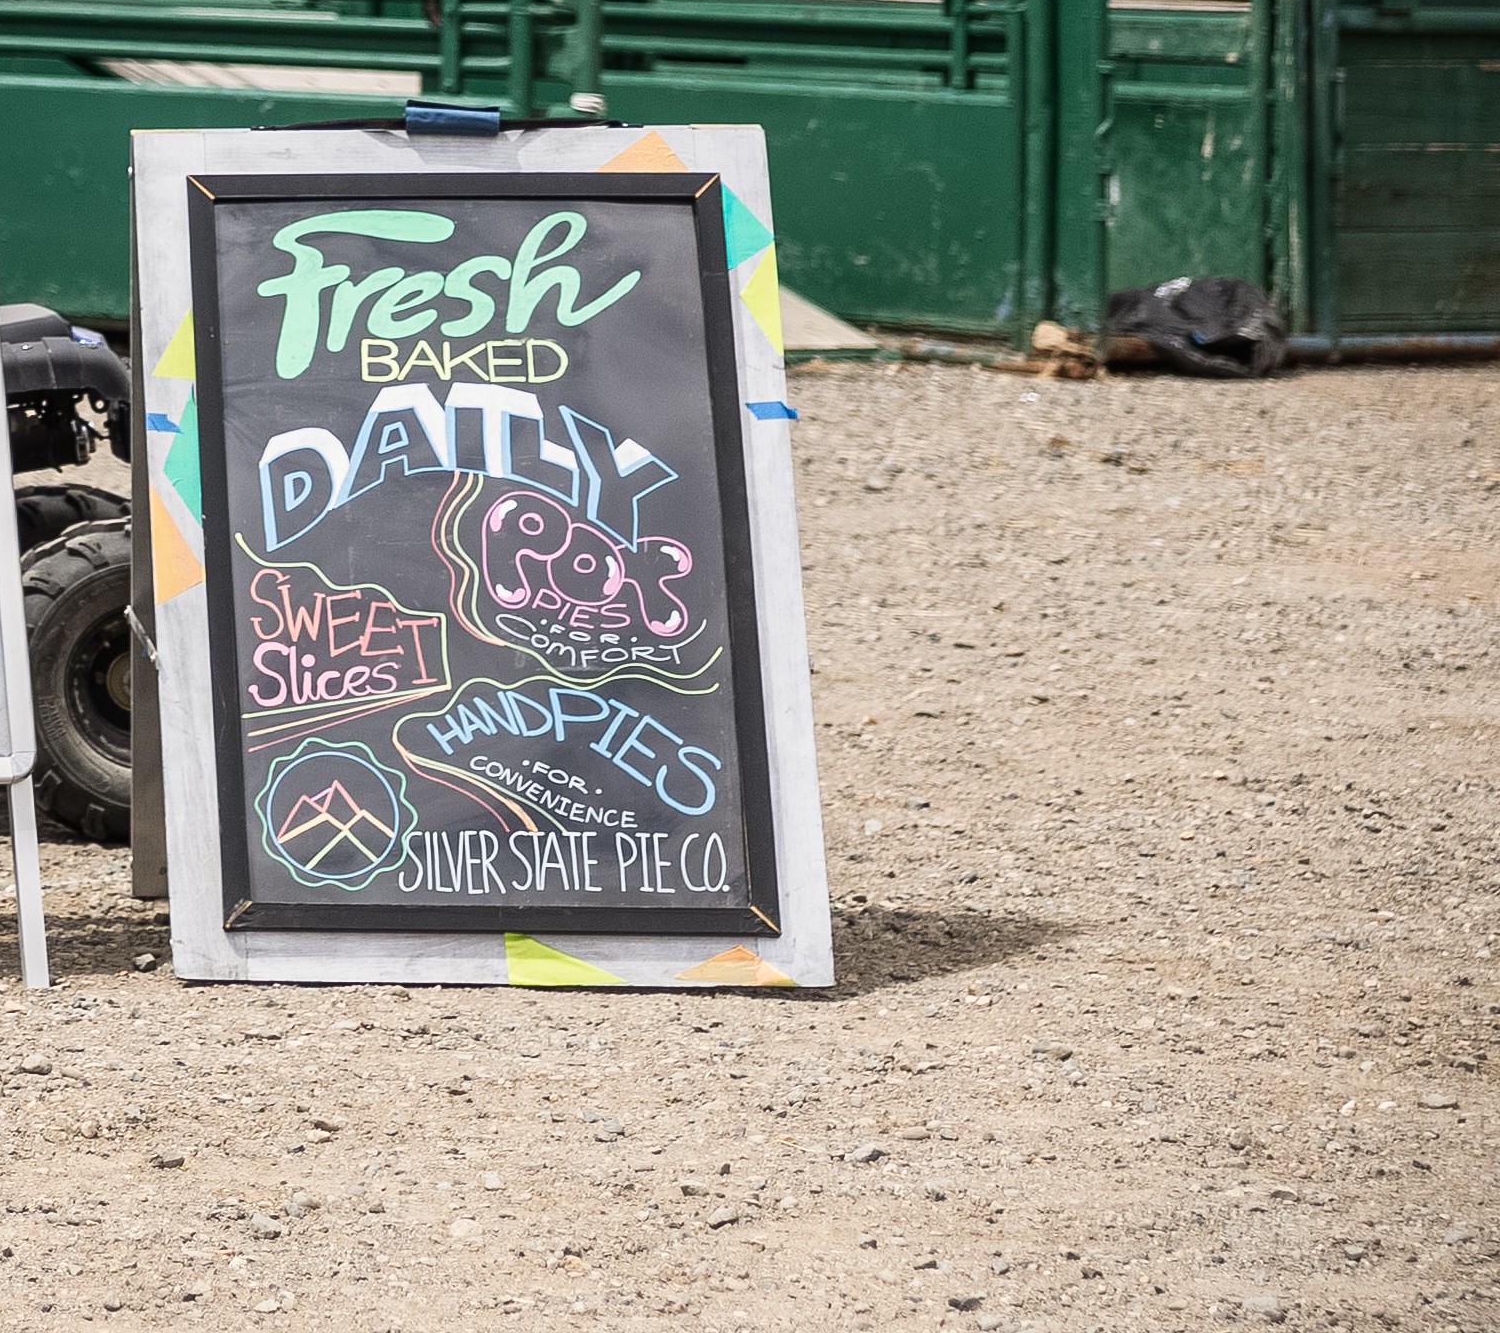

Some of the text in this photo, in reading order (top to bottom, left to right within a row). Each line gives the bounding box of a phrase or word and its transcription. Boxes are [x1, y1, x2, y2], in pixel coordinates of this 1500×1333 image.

[257, 209, 642, 379] Fresh
[360, 338, 569, 383] BAKED
[258, 382, 679, 553] DAILY
[250, 568, 438, 685] SWEET
[495, 614, 685, 667] COMFORT
[532, 588, 632, 630] PIES
[248, 642, 401, 708] Slices
[469, 755, 638, 828] CONVENIENCE
[398, 829, 731, 895] SILVER STATE PIE CO.
